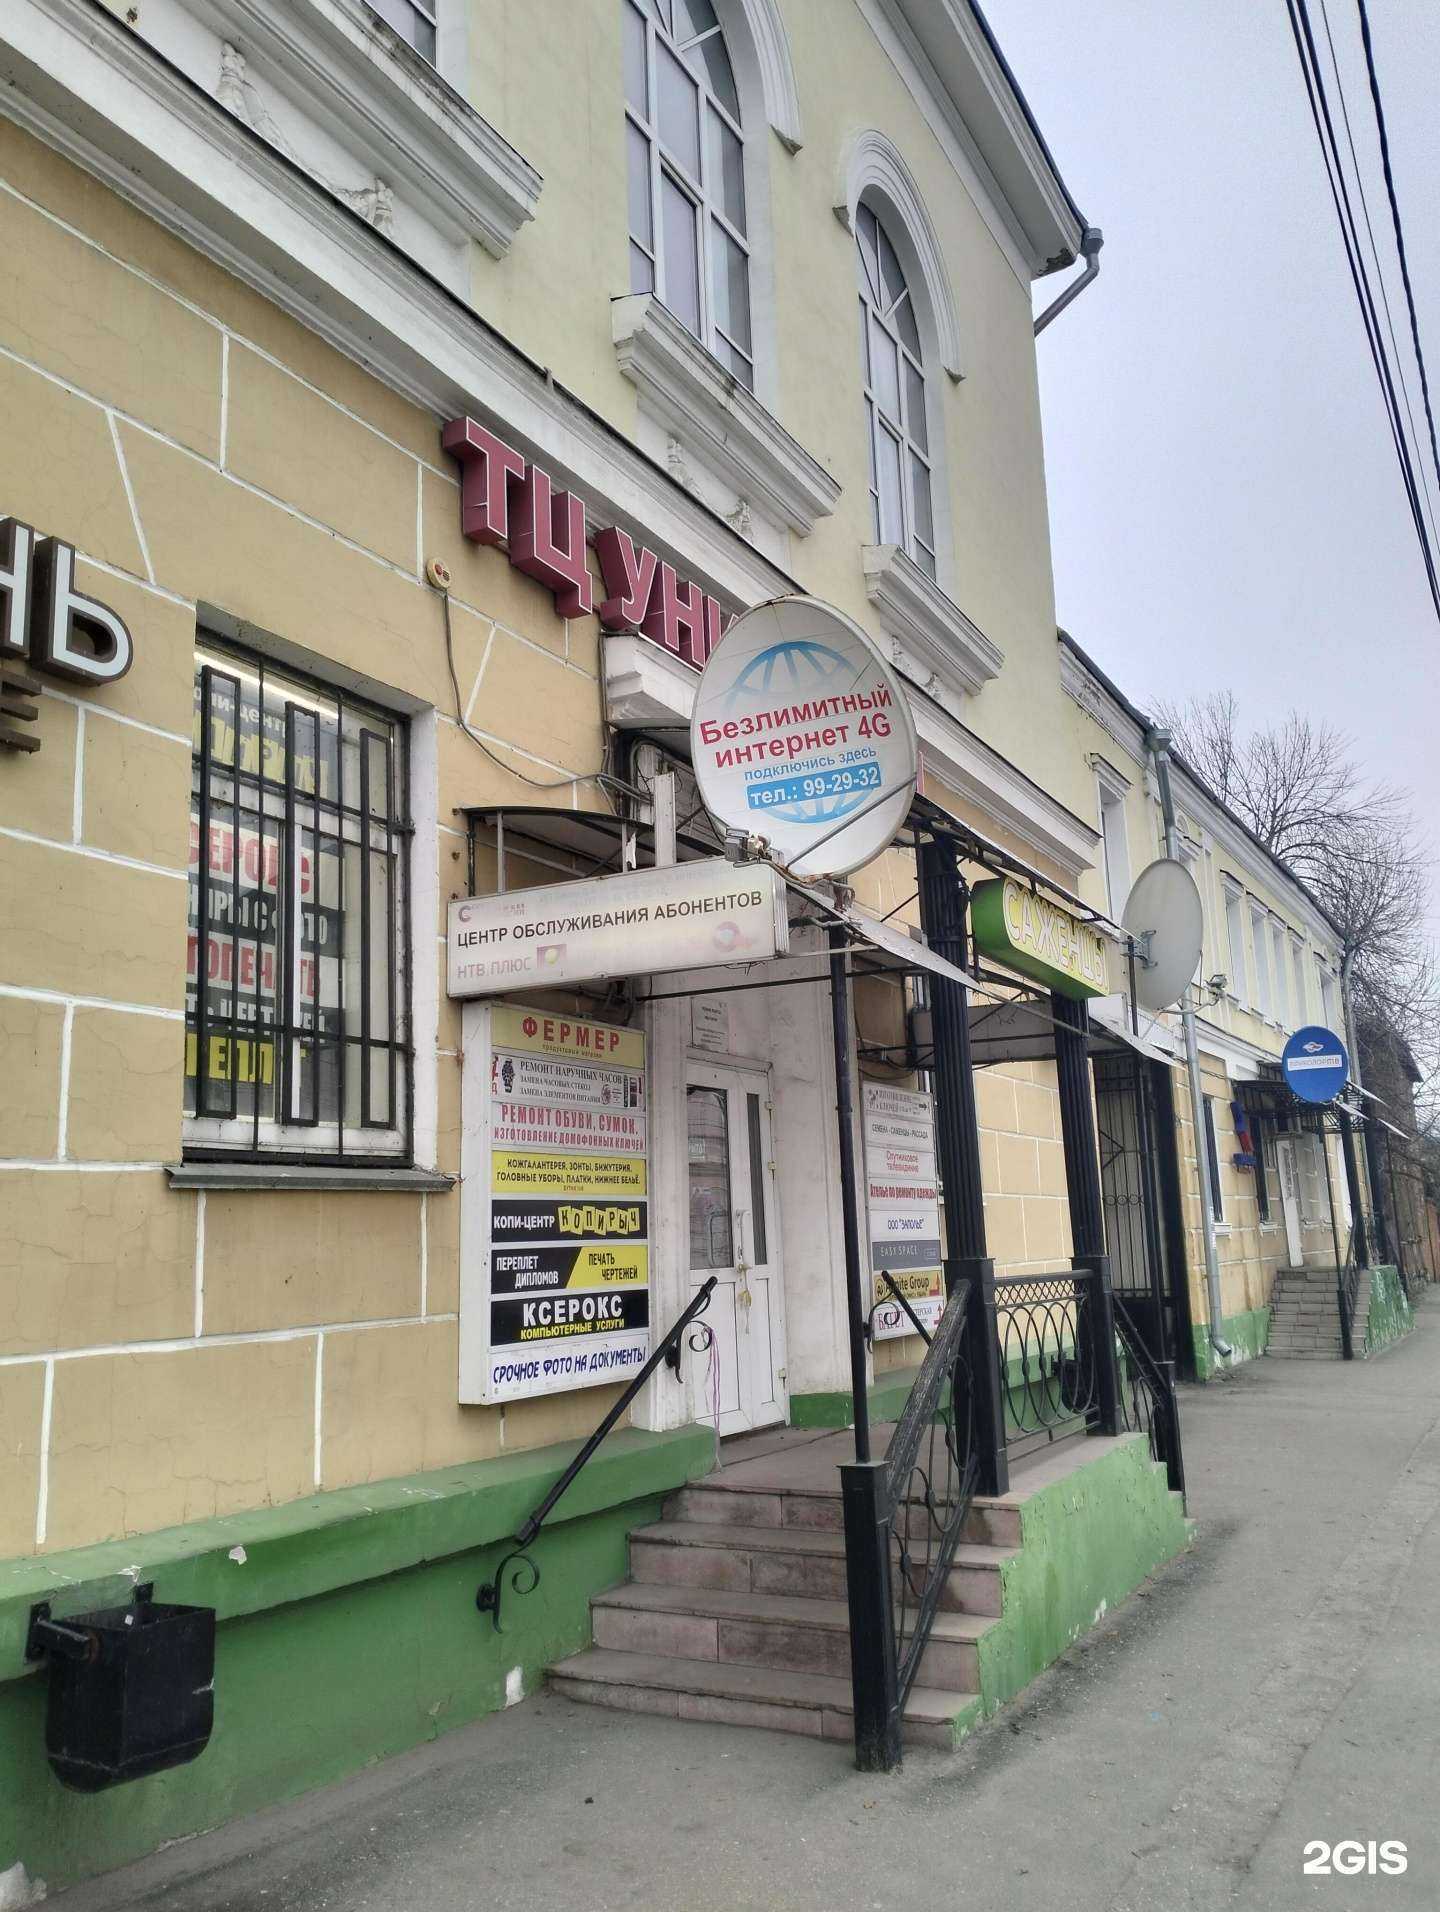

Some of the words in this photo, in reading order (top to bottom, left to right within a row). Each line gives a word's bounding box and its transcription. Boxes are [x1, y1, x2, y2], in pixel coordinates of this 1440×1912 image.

[449, 415, 593, 617] ТЦ
[700, 683, 893, 745] Безлимитный
[715, 723, 849, 769] интернет
[857, 712, 892, 740] 4G
[744, 754, 836, 781] подключись
[839, 746, 877, 764] здесь
[750, 786, 798, 806] тел.:
[803, 766, 880, 797] 99-29-32
[457, 926, 509, 949] ЦЕНТР
[513, 906, 649, 940] ОБСЛУЖИВАНИЯ
[654, 891, 762, 920] АБОНЕНТОВ
[522, 1016, 620, 1051] ФЕРМЕР
[520, 1061, 554, 1075] РЕМОНТ
[555, 1065, 598, 1080] НАРУЧНЫХ
[599, 1071, 622, 1085] ЧАСОВ
[501, 1104, 551, 1126] РЕМОНТ
[555, 1110, 596, 1132] ОБУВИ,
[494, 1127, 558, 1143] ИЗГОТОВЛЕНИЕ
[559, 1133, 614, 1147] ДОМОФОННЫХ
[615, 1137, 644, 1150] КЛЮЧЕЙ
[496, 1171, 537, 1182] ГОЛОВНЫЕ
[594, 1175, 620, 1184] НИЖНЕЕ
[493, 1215, 555, 1231] КОПИ-ЦЕНТР
[559, 1208, 638, 1234] КОПИРЫЧ
[496, 1255, 538, 1271] ПЕРЕПЛЕТ
[588, 1252, 615, 1266] ПЕЧАТЬ
[514, 1271, 559, 1289] ДИПЛОМОВ
[601, 1266, 638, 1281] ЧЕРТЕЖЕЙ
[909, 1275, 930, 1291] Group
[523, 1295, 623, 1327] КСЕРОКС
[520, 1321, 593, 1340] КОМПЬЮТЕРНЫЕ
[596, 1318, 625, 1331] УСЛУГИ
[493, 1360, 540, 1384] СРОЧНОЕ
[543, 1356, 573, 1376] ФОТО
[575, 1354, 587, 1373] НА
[589, 1347, 646, 1372] ДОКУМЕНТЫ
